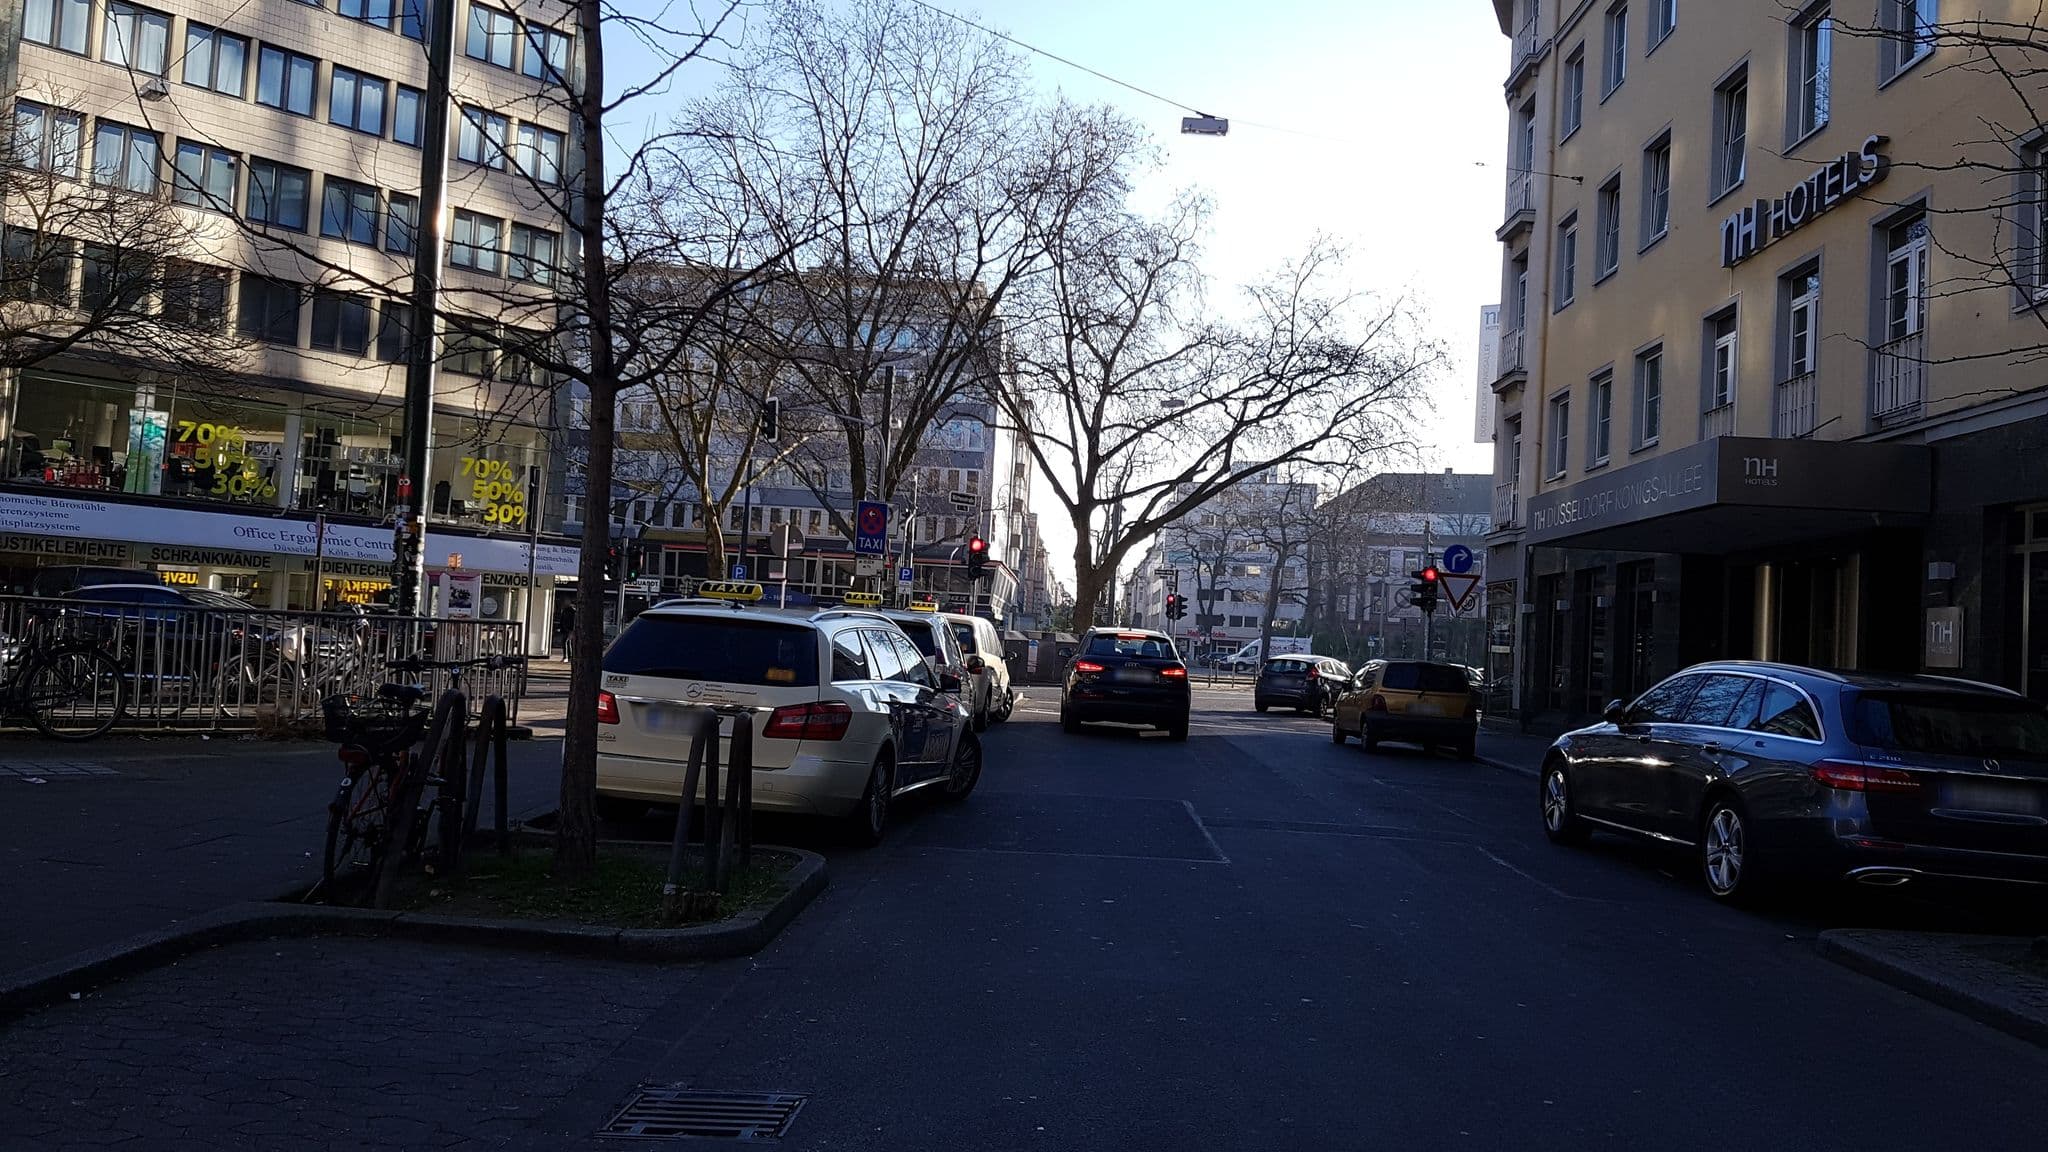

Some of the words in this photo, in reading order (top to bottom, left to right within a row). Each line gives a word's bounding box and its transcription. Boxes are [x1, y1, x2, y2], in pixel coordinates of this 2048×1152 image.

[1770, 135, 1882, 239] HOTELS
[178, 420, 244, 448] 70%
[461, 457, 513, 480] 70%
[210, 473, 276, 499] 30%
[1745, 478, 1778, 486] HOTELS
[472, 480, 524, 503] 50%
[51, 499, 106, 512] Bürostühle
[2, 520, 81, 531] itsplatzsysteme
[306, 523, 337, 535] OC
[233, 526, 276, 544] Office
[354, 536, 396, 551] Centru
[858, 537, 884, 550] TAXI
[151, 547, 271, 569] SCHRANKWÄNDE
[735, 567, 744, 578] P
[902, 569, 911, 580] P
[709, 583, 749, 594] TAXI
